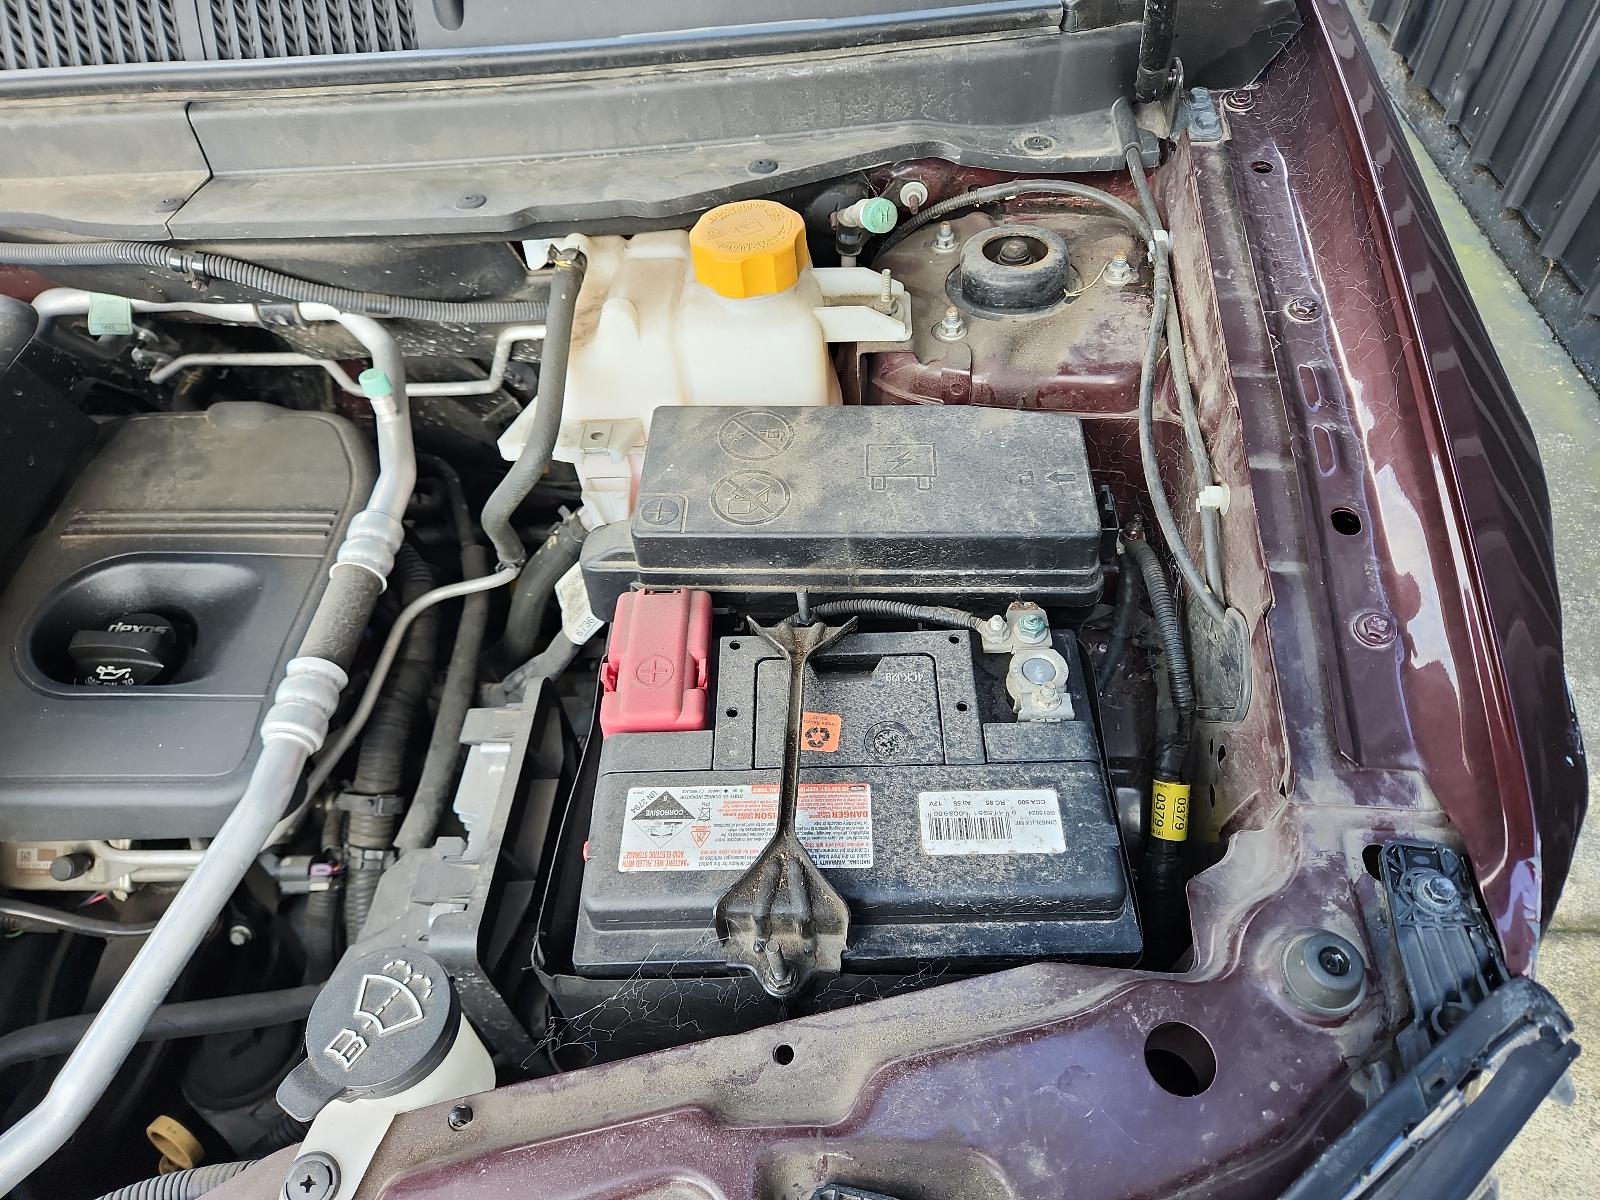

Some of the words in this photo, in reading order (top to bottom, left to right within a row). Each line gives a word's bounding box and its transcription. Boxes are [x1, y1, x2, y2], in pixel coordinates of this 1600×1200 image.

[108, 622, 170, 634] dexos
[886, 673, 923, 682] 4CKJ29
[647, 791, 658, 800] UN
[631, 799, 647, 813] 2794
[1154, 794, 1166, 827] 0379
[1174, 798, 1186, 830] 0379
